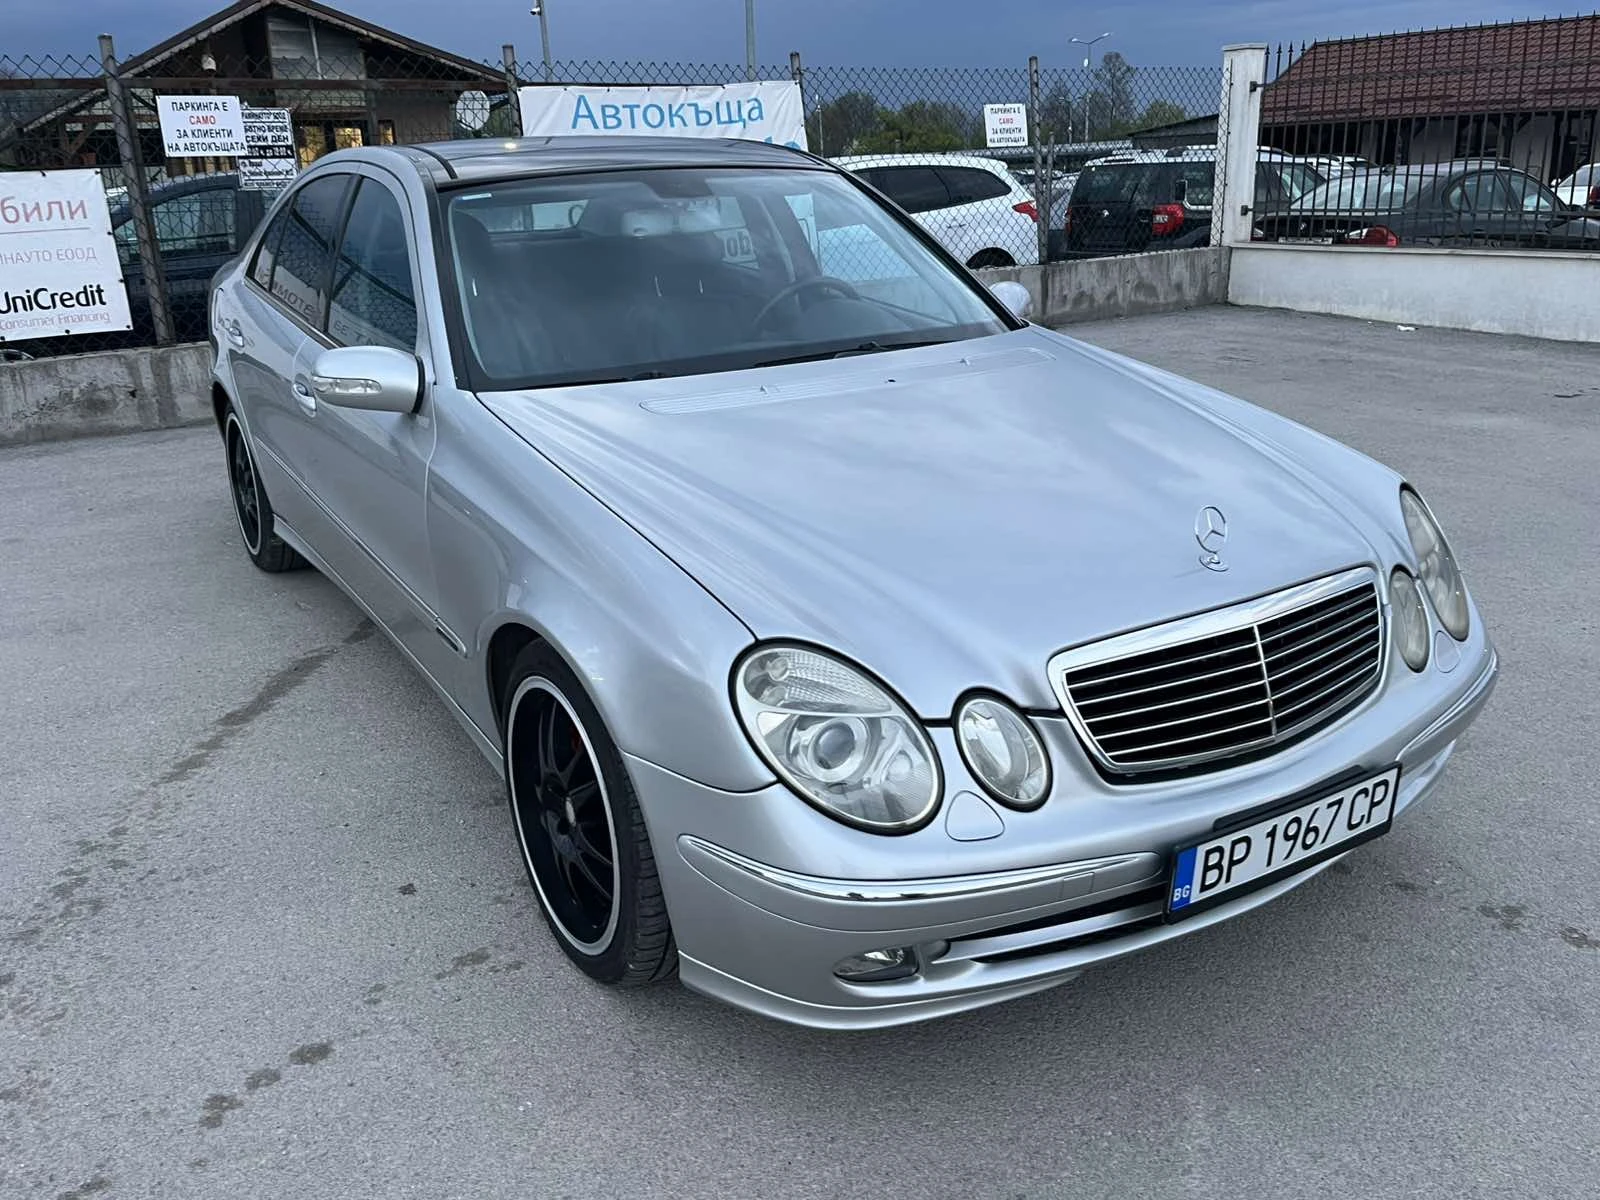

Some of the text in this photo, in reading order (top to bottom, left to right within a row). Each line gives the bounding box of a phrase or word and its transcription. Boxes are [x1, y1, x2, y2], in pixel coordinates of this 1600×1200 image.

[171, 101, 229, 112] ПАРКИНГА Е
[571, 94, 764, 129] Автокъща
[188, 115, 217, 125] САМО
[176, 128, 233, 139] ЗА КЛИЕНТИ
[167, 143, 181, 153] НА
[183, 142, 246, 153] АВТОКЪЩАТА
[1199, 778, 1390, 893] BP 1967 CP
[1173, 884, 1190, 901] BG
